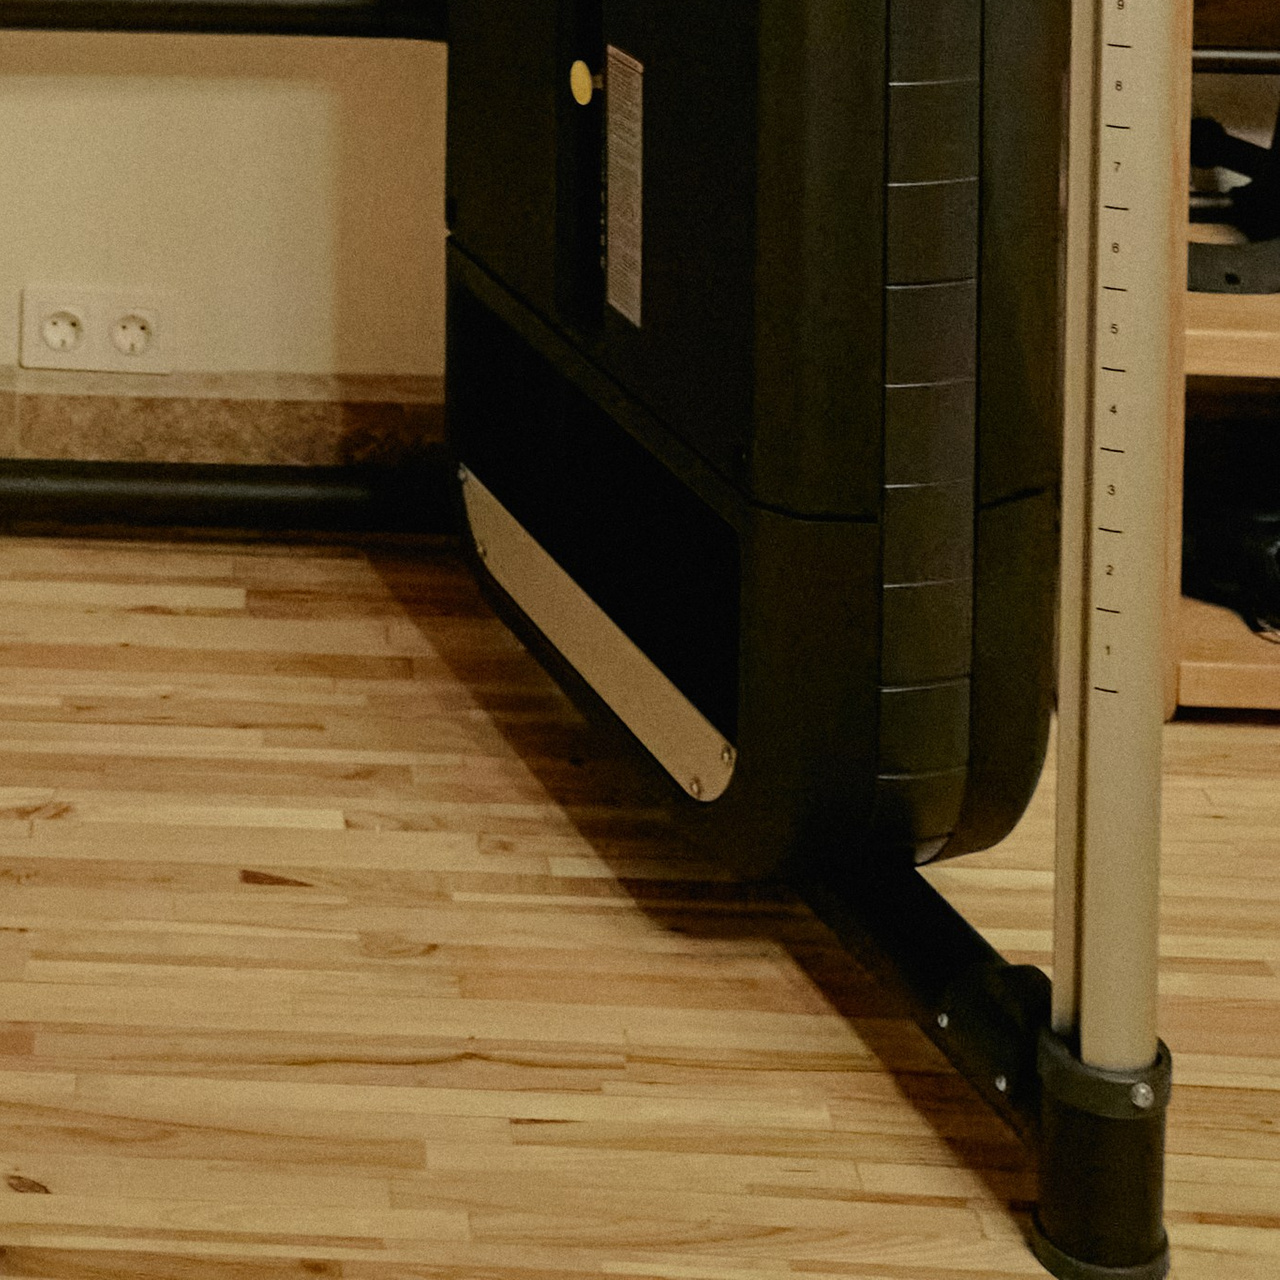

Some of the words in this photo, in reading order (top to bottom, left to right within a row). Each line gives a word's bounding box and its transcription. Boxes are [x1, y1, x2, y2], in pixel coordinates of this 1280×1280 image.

[1117, 0, 1125, 10] 9
[1115, 80, 1123, 91] 8
[1113, 161, 1121, 172] 7
[1112, 242, 1120, 253] 6
[1110, 323, 1119, 334] 5
[1109, 405, 1117, 414] 4
[1107, 484, 1115, 496] 3
[1106, 565, 1114, 576] 2
[1105, 645, 1111, 655] 1
